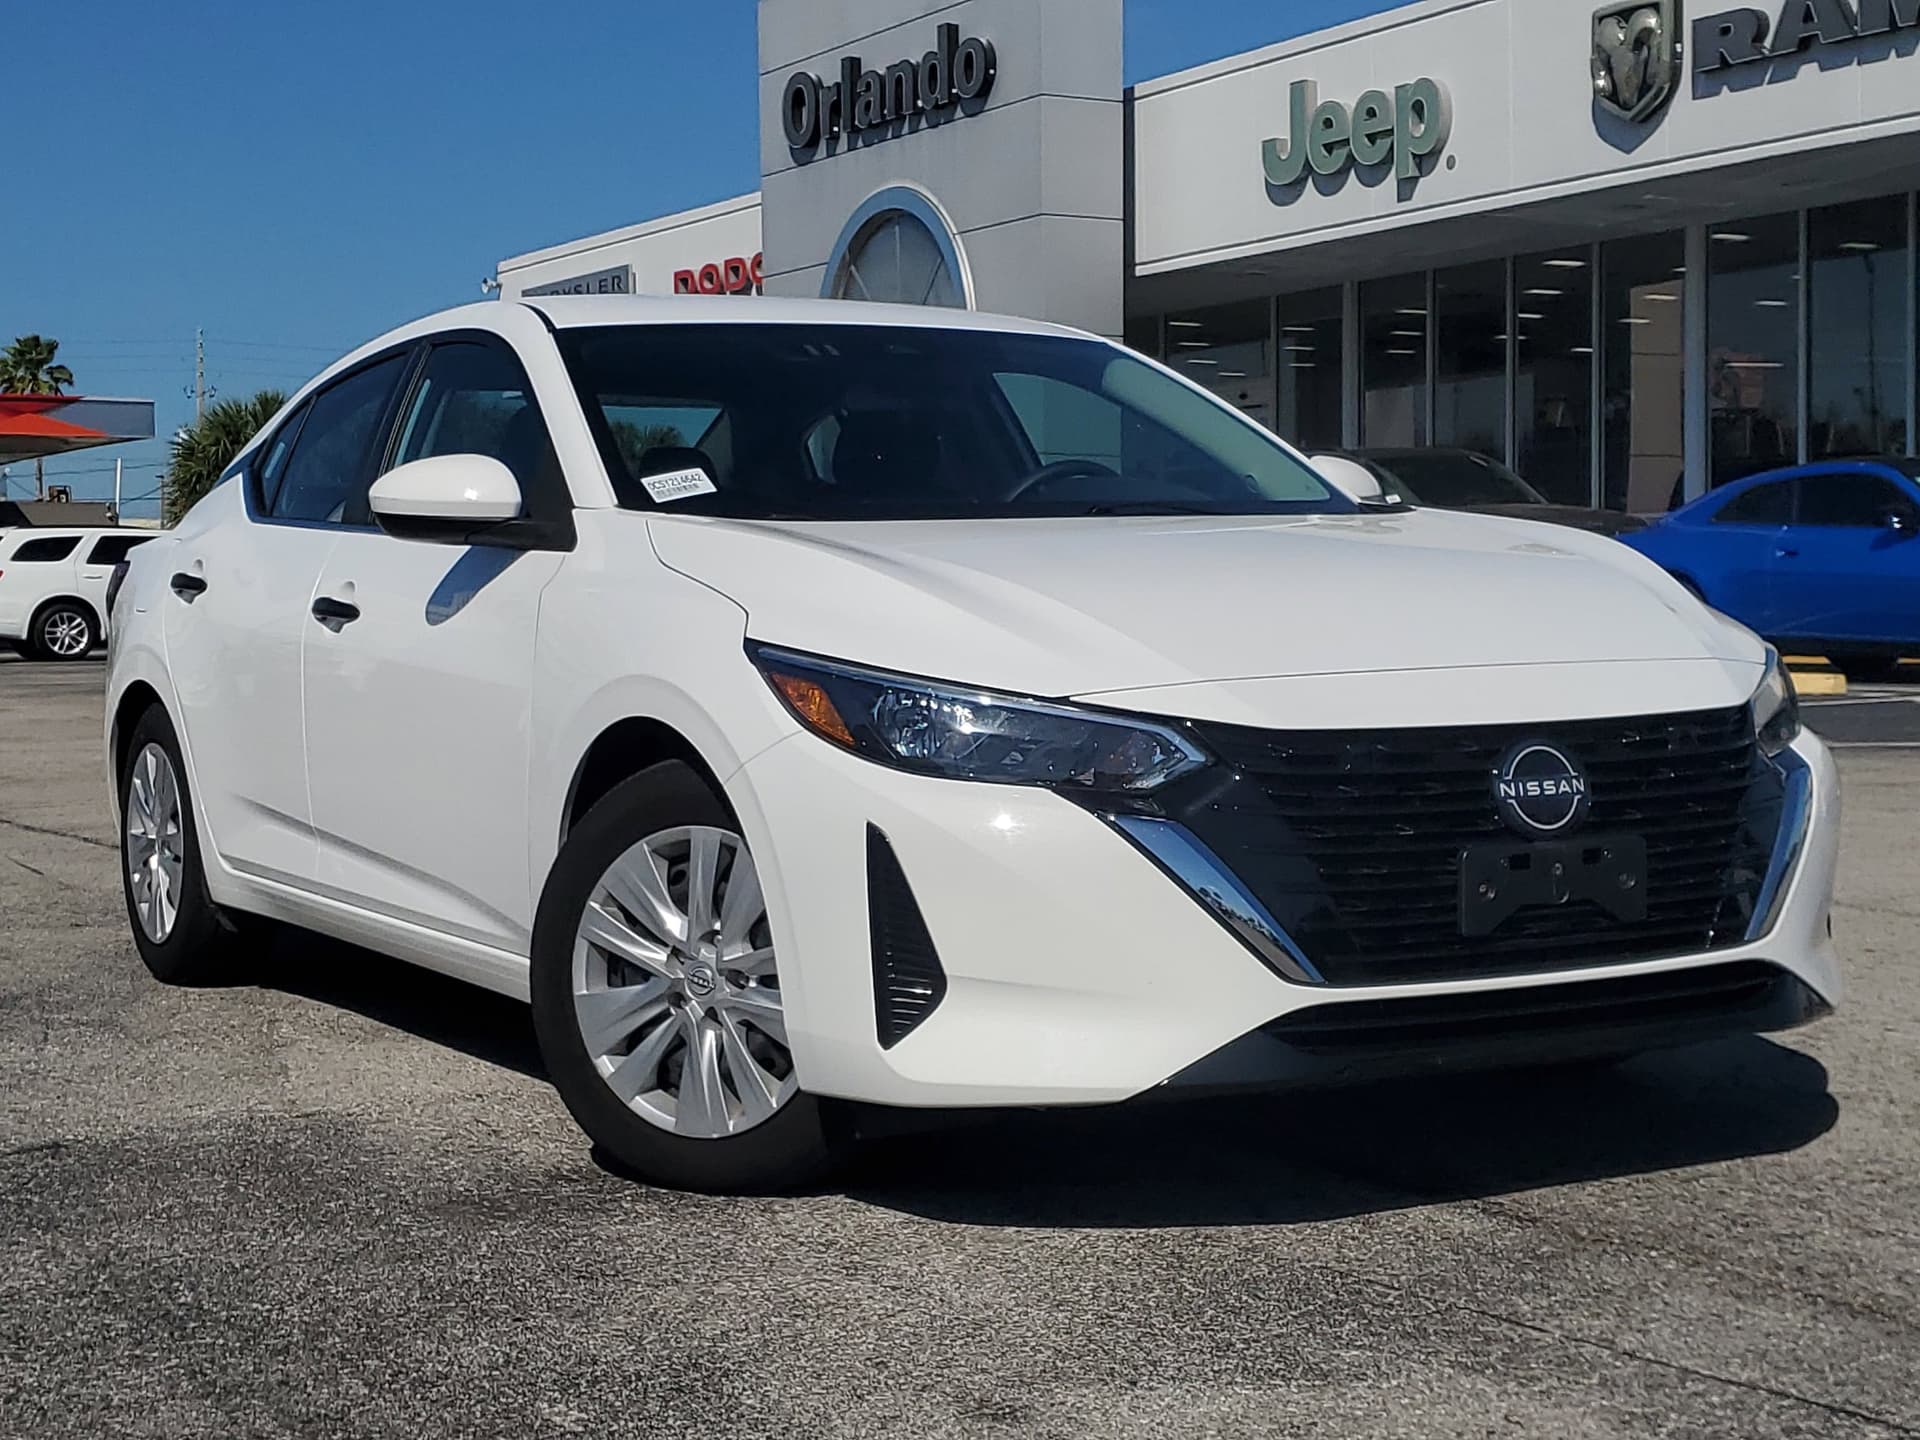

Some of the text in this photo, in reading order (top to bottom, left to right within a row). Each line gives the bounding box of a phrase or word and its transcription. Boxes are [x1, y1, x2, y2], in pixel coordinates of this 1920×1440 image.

[783, 23, 997, 148] Orlando
[548, 274, 623, 296] YSLER
[1500, 779, 1585, 797] NISSAN
